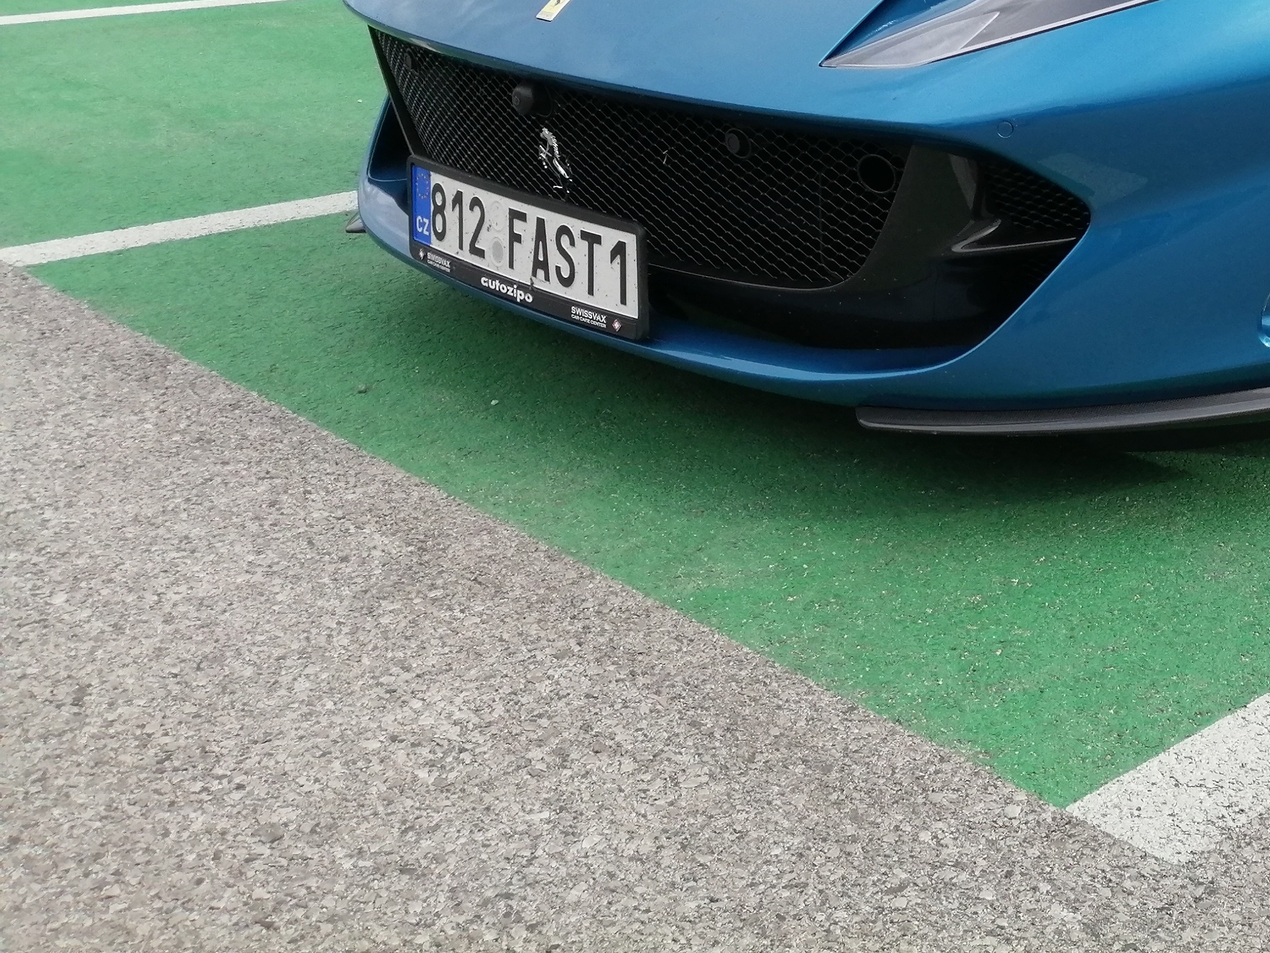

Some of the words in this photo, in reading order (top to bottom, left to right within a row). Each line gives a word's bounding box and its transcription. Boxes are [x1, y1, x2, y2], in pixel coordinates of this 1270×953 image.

[416, 215, 430, 236] CZ
[431, 182, 486, 259] 812
[508, 207, 627, 306] FAST1
[481, 276, 533, 303] autozipo
[571, 305, 607, 324] SWISSVAX
